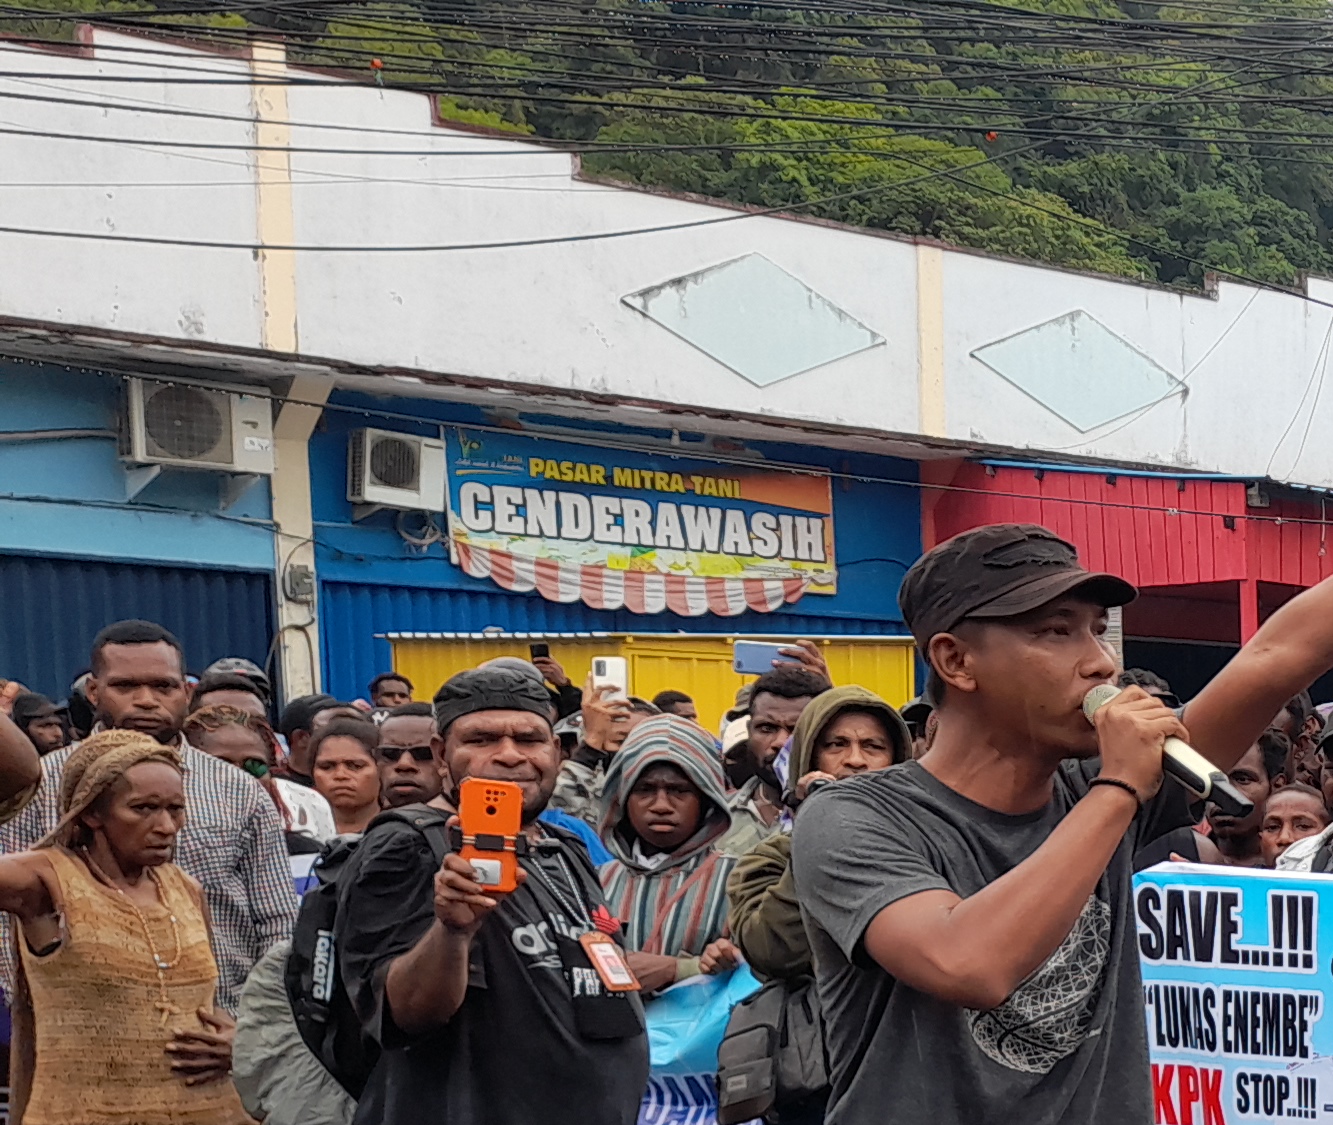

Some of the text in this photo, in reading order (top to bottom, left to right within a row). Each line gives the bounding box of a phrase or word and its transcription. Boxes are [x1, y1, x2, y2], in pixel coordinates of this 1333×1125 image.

[528, 457, 606, 485] PASAR
[613, 466, 686, 494] MITRA
[691, 475, 741, 498] TANI
[459, 481, 826, 563] CENDERAWASIH
[1137, 886, 1313, 969] SAVE...!!!
[1236, 1071, 1317, 1119] STOP..!!!
